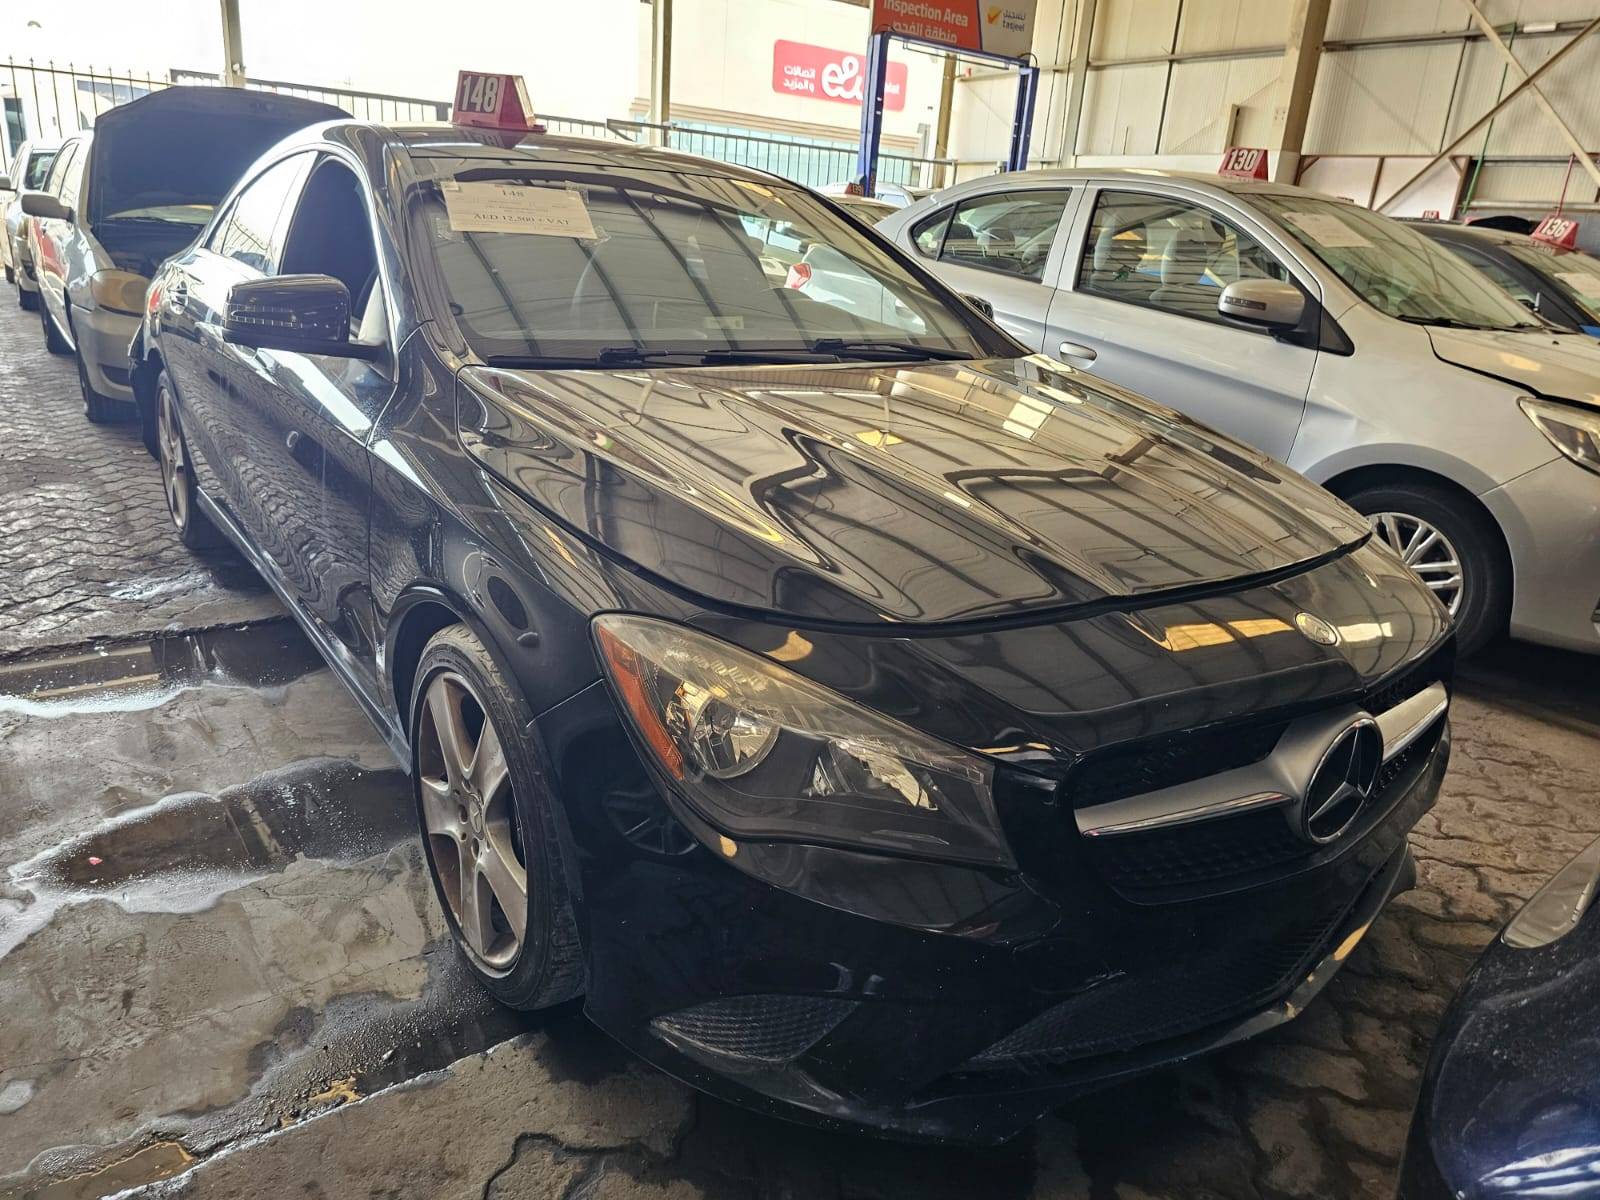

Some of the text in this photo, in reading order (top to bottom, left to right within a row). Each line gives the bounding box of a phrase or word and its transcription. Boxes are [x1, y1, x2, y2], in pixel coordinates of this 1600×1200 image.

[944, 9, 969, 27] Area
[1003, 20, 1025, 32] tasjeel
[925, 25, 957, 43] منطقة
[783, 65, 816, 79] اتصالات
[783, 78, 815, 93] والمزيد
[461, 75, 499, 113] 148
[1226, 149, 1258, 171] 130
[501, 189, 525, 198] 148
[473, 213, 498, 221] AED
[544, 217, 570, 226] VAT
[1541, 218, 1570, 237] 136
